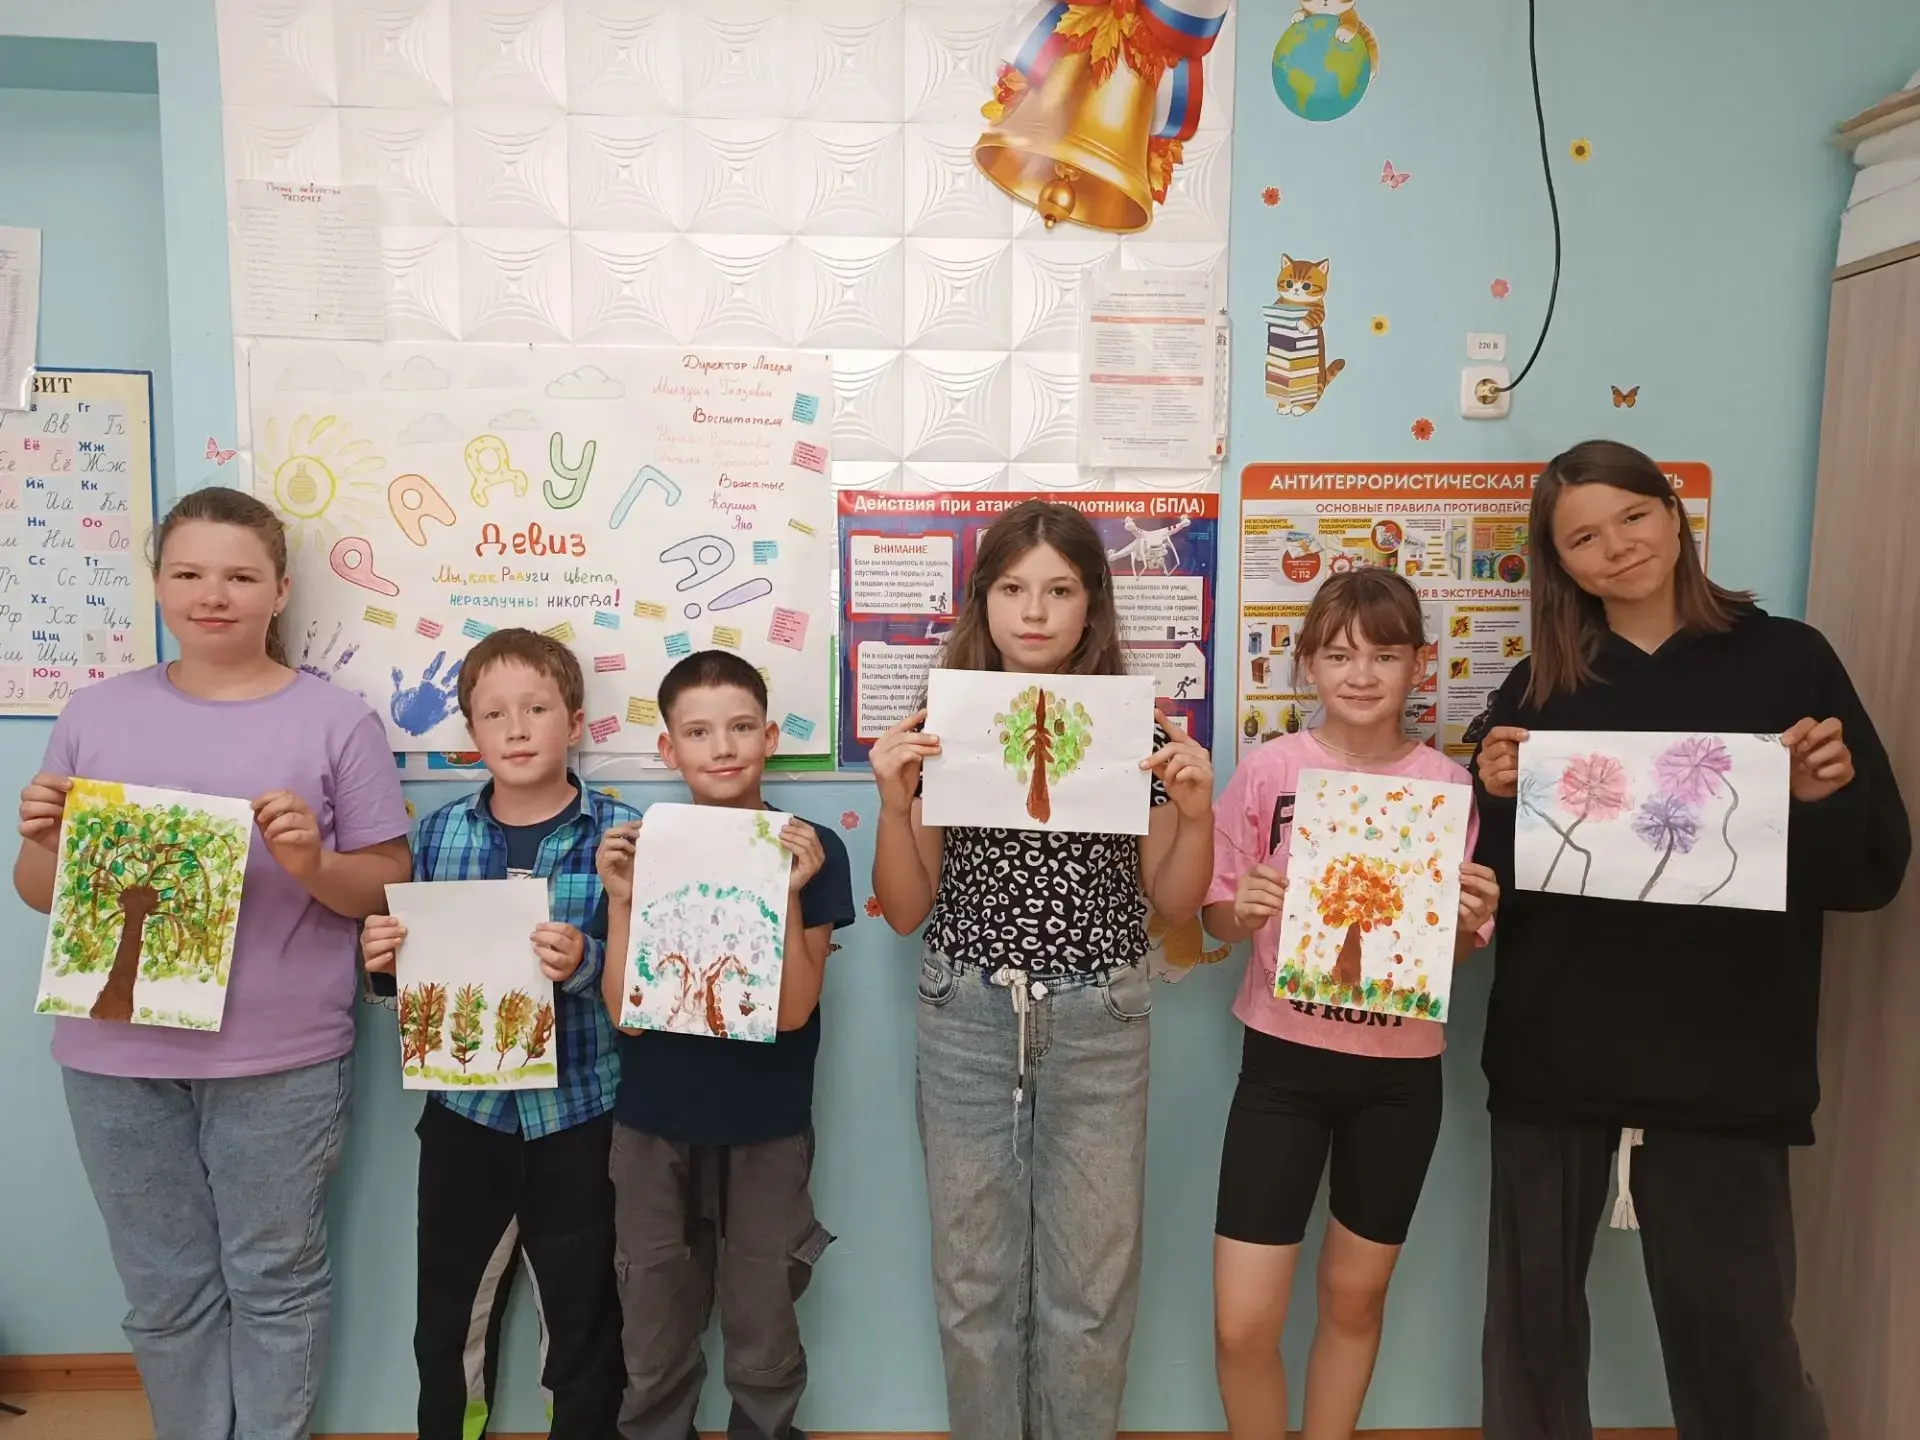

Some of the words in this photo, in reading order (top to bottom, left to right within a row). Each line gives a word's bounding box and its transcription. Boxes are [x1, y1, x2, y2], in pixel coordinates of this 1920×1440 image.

[682, 354, 748, 375] Директор
[753, 355, 793, 375] Лагеря
[32, 376, 72, 393] ВИТ
[79, 441, 104, 452] Жж
[81, 453, 127, 472] Жж
[26, 477, 44, 489] Йй
[81, 480, 98, 490] Кк
[718, 473, 785, 491] Вожатые
[1270, 474, 1524, 490] АНТИТЕРРОРИСТИЧЕСКАЯ
[100, 491, 128, 511] Кк
[709, 490, 757, 515] Карина
[854, 494, 935, 512] Действия
[941, 499, 971, 515] при
[976, 500, 1021, 512] атак
[1150, 497, 1205, 516] (БПЛА)
[1316, 503, 1383, 513] ОСНОВНЫЕ
[1386, 503, 1441, 513] ПРАВИЛА
[1444, 502, 1530, 514] ПРОТИВОДЕЙС
[27, 517, 45, 526] Нн
[82, 518, 102, 527] Оо
[731, 514, 753, 531] Яна
[109, 529, 129, 548] Оо
[475, 522, 586, 557] Девиз
[873, 544, 928, 554] ВНИМАНИЕ
[28, 555, 46, 565] Сс
[84, 557, 99, 566] Тт
[57, 568, 77, 586] Сс
[31, 594, 47, 604] Хх
[86, 594, 105, 606] Цц
[1431, 589, 1438, 597] В
[1440, 589, 1531, 598] ЭКСТРЕМАЛЬНЫ
[46, 606, 78, 624] Хх
[33, 668, 60, 678] Юю
[88, 668, 104, 679] Яя
